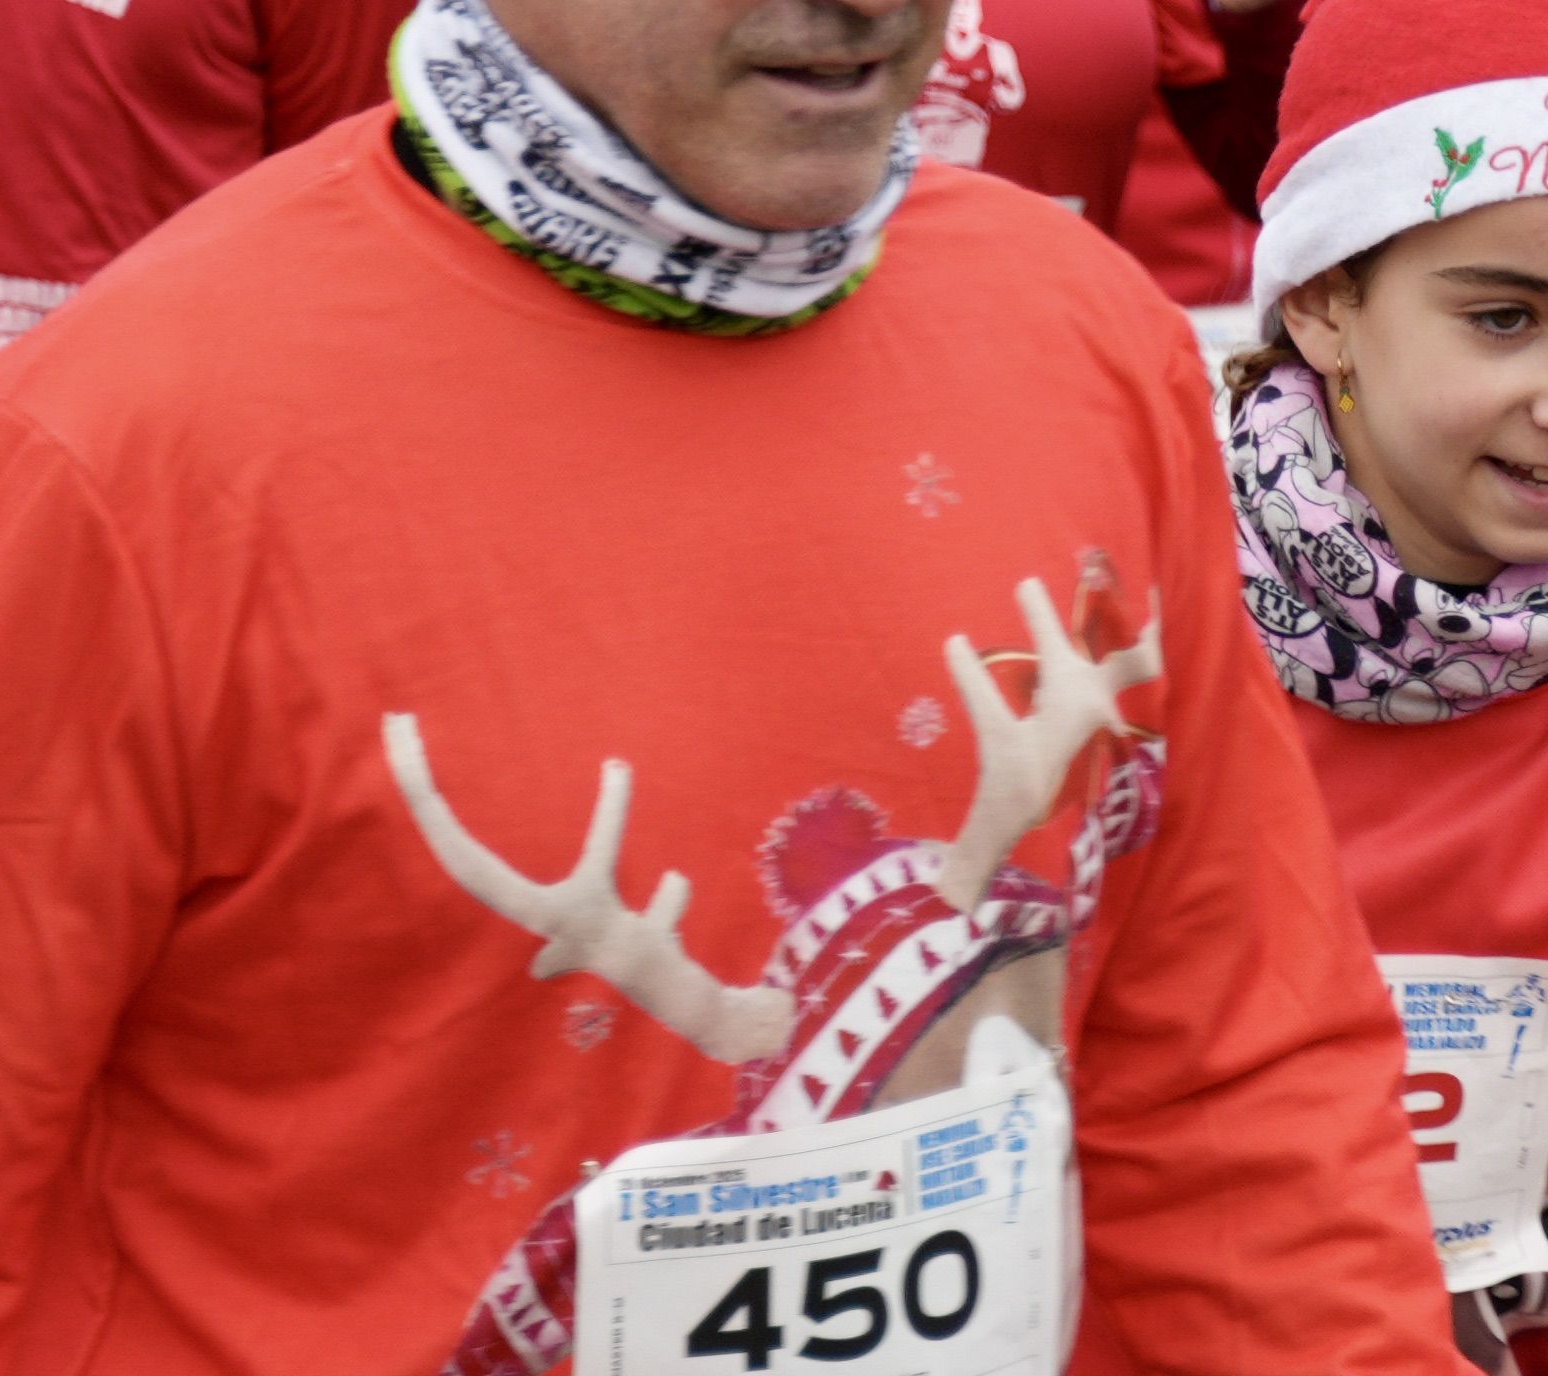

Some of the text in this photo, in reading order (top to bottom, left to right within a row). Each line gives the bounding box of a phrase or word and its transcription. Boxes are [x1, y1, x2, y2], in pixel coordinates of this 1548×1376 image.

[642, 1189, 701, 1220] San
[709, 1174, 841, 1214] Silvestre
[639, 1199, 896, 1253] Ciudad de Lucena
[685, 1229, 979, 1371] 450
